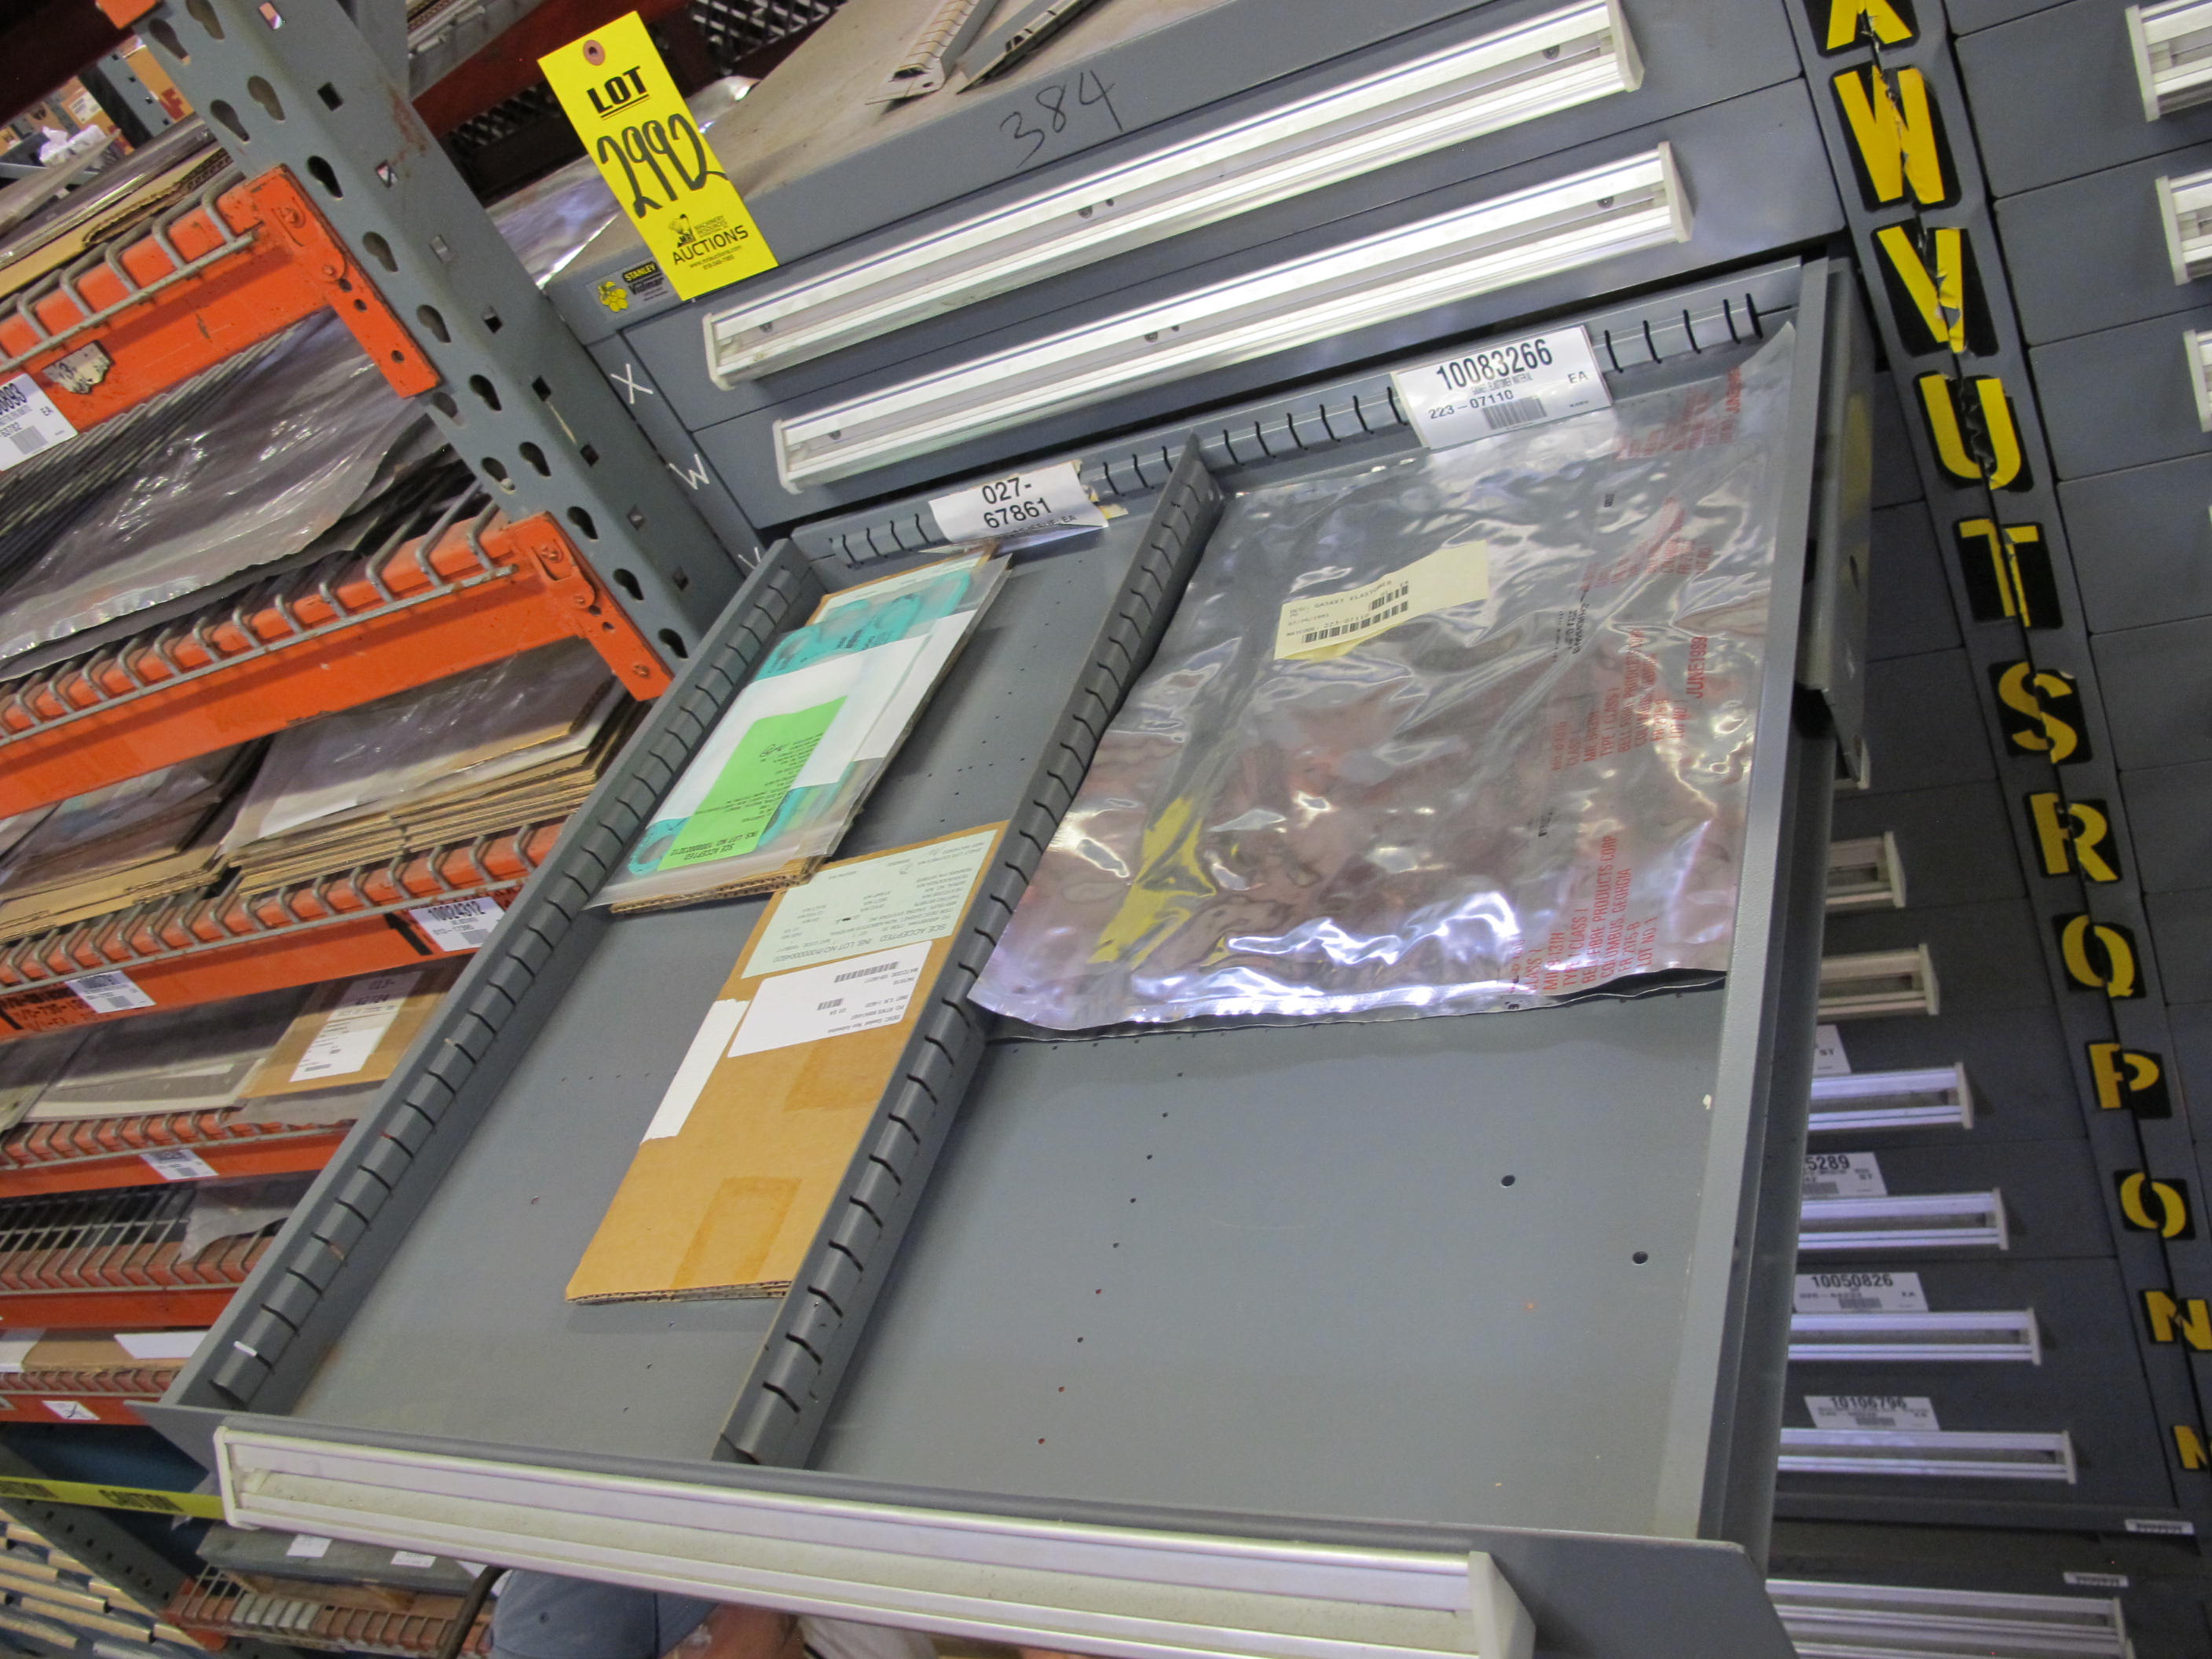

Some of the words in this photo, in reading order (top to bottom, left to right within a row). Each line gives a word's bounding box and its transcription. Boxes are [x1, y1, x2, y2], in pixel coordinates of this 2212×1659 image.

[587, 66, 646, 114] LOT
[999, 71, 1123, 170] 384
[1833, 65, 1944, 204] W
[597, 113, 729, 218] 2992
[672, 225, 749, 266] AUCTIONS
[624, 263, 657, 281] STANLEY
[1877, 226, 1965, 353] V
[610, 364, 654, 404] X
[1436, 339, 1553, 391] 10083266
[1567, 371, 1589, 384] EA
[1919, 374, 2021, 490] U
[982, 477, 1032, 504] 027-
[983, 496, 1052, 529] 67861
[1959, 518, 2039, 628] T
[1998, 661, 2078, 764] S
[1601, 836, 1616, 862] CORP
[2030, 793, 2119, 881] R
[1592, 865, 1613, 922] PRODUCTS
[1612, 867, 1632, 914] GEORGIA
[838, 942, 855, 950] LOT
[880, 927, 927, 942] ACCEPTED
[928, 924, 947, 932] SCE
[1569, 917, 1588, 949] CLASS
[1587, 926, 1604, 955] FIBRE
[1642, 927, 1657, 943] NO
[823, 945, 837, 954] NO
[1636, 947, 1653, 967] LOT
[2062, 915, 2134, 998] Q
[1582, 960, 1599, 983] BELL
[2088, 1042, 2159, 1109] P
[2120, 1172, 2187, 1239] O
[1811, 1274, 1894, 1288] 10050826
[2145, 1291, 2212, 1350] N
